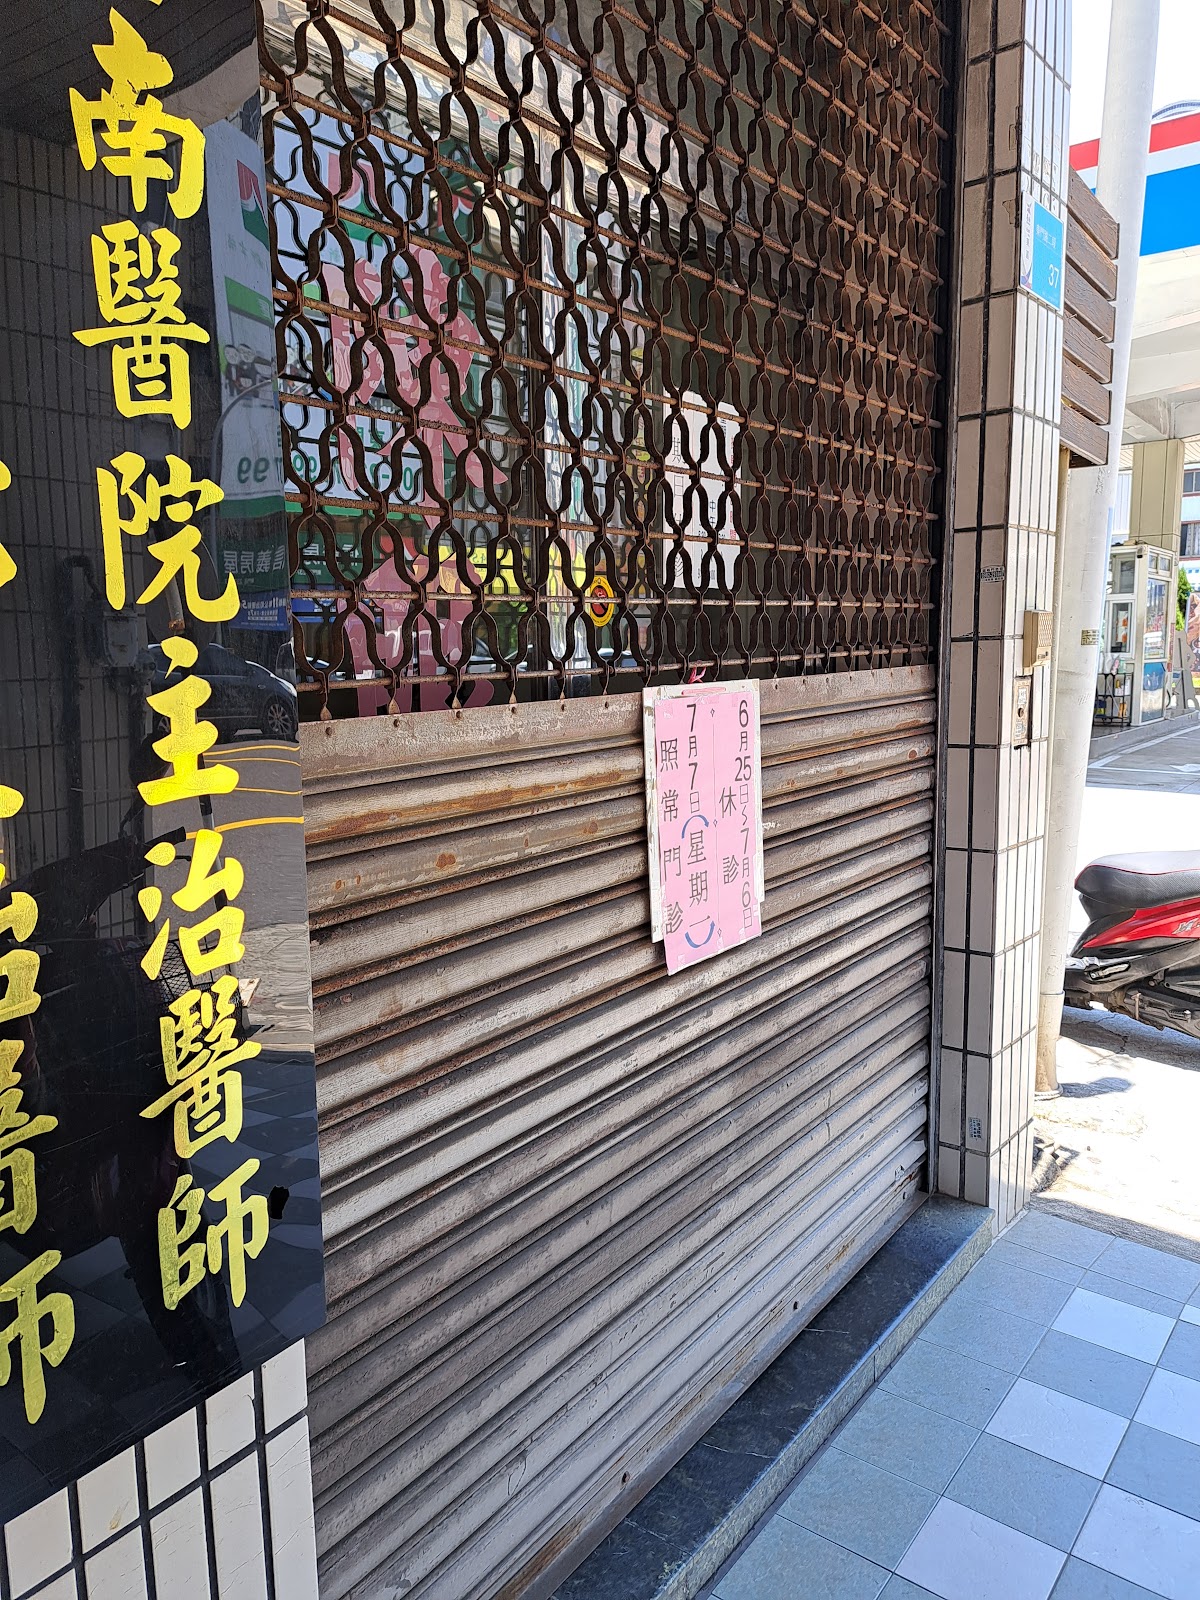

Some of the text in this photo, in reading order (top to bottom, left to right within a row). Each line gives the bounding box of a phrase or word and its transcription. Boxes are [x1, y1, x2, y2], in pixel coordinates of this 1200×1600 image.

[1048, 263, 1060, 289] 37
[69, 0, 269, 1308] 南醫院主治醫師
[659, 737, 684, 936] 照常門診
[719, 785, 740, 886] 休診
